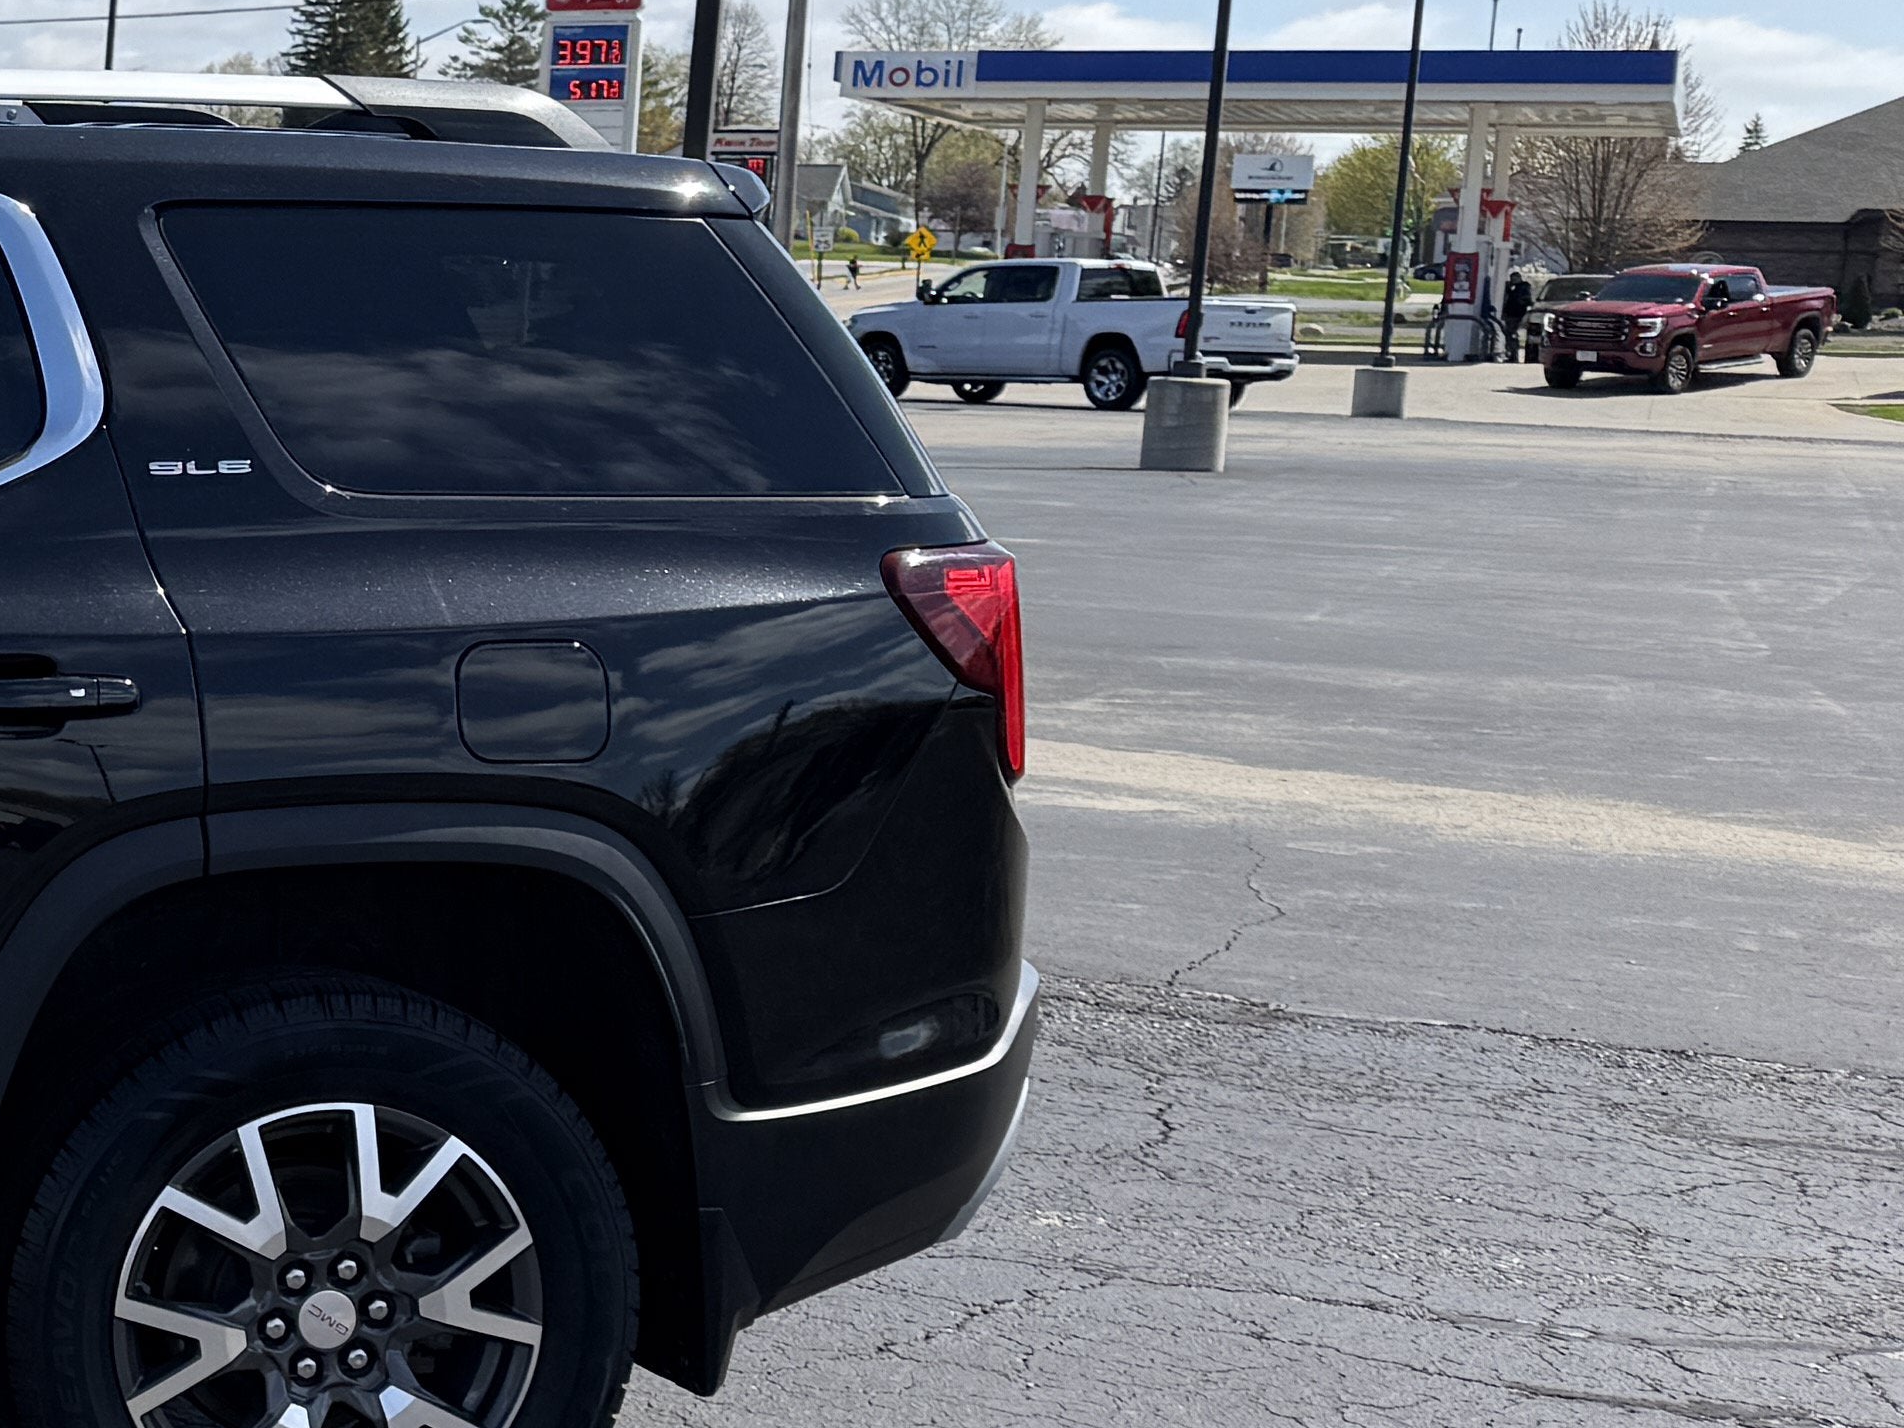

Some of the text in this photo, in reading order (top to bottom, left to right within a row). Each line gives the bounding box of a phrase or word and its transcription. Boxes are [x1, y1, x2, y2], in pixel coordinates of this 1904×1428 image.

[852, 59, 964, 88] Mobil
[148, 459, 252, 475] SLE
[307, 1303, 349, 1336] GMC
